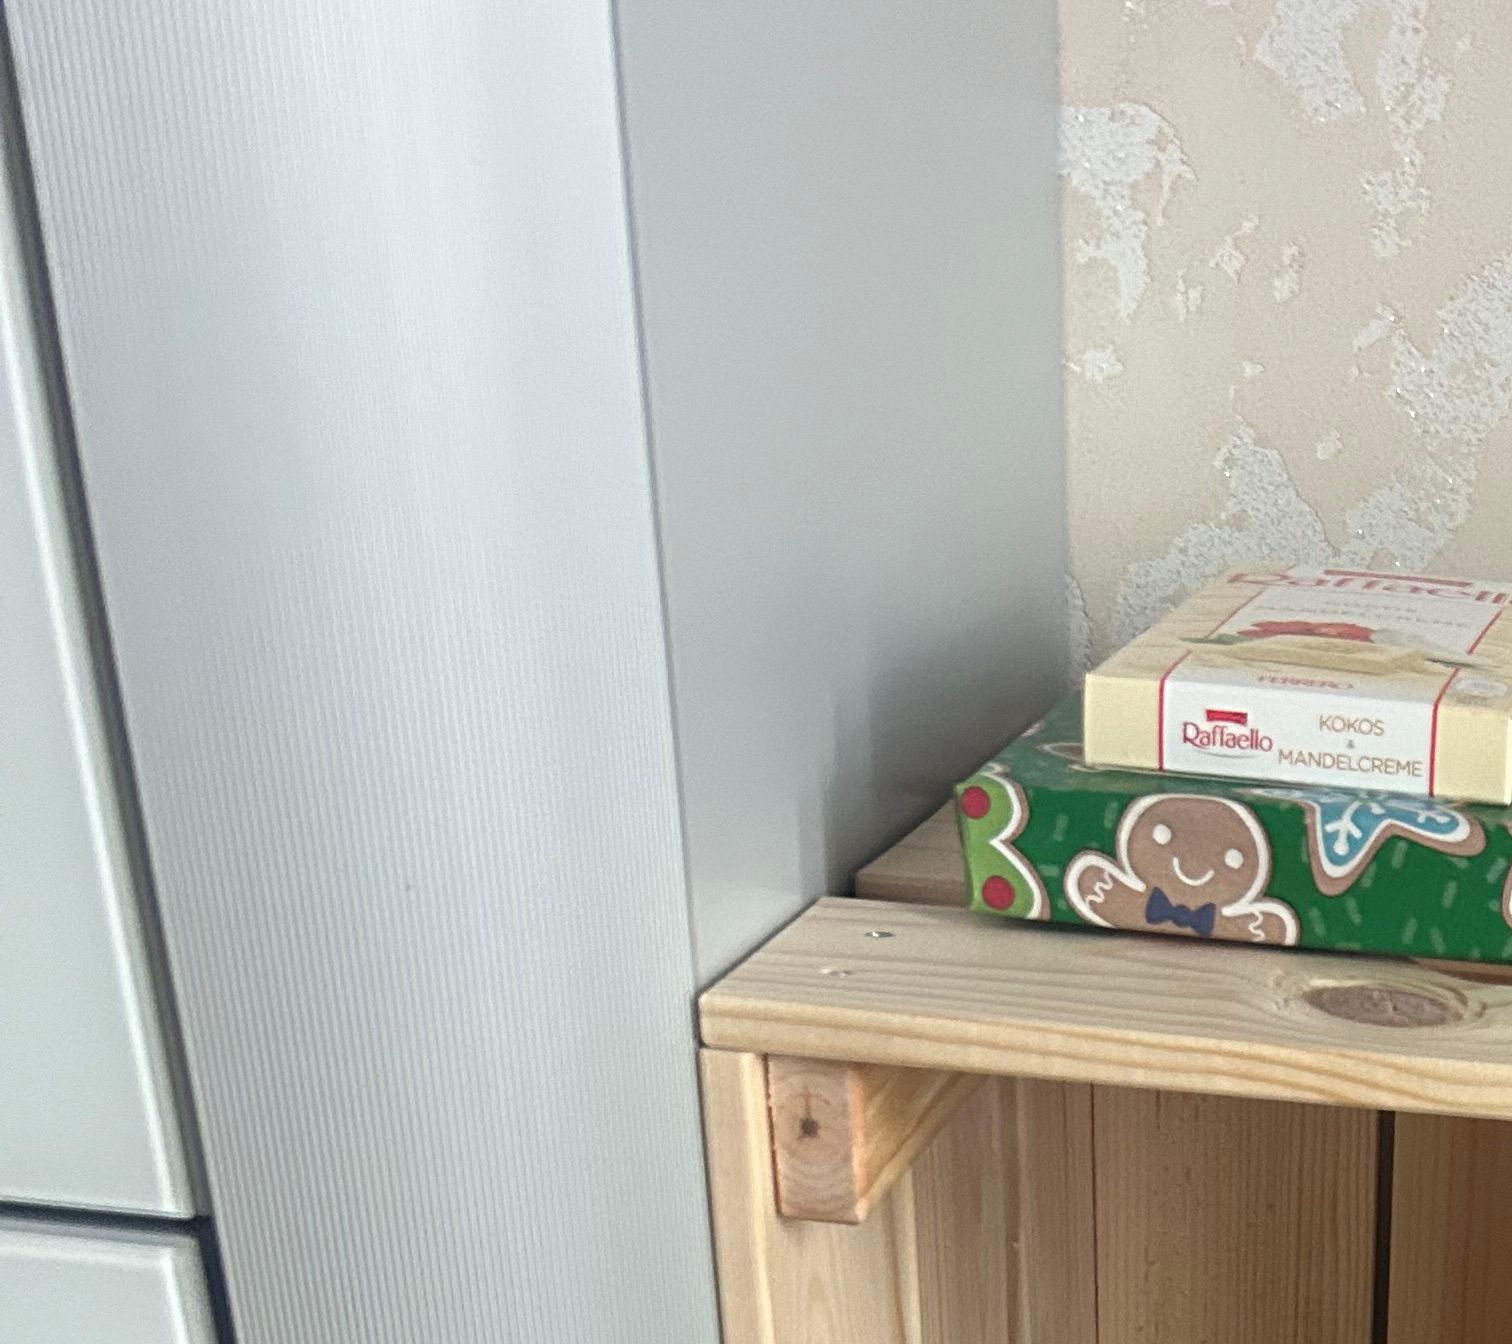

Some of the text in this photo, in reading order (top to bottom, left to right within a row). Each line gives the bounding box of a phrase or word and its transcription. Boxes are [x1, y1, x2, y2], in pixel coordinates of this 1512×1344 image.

[1182, 721, 1274, 752] Raffaello
[1318, 714, 1386, 737] KOKOS
[1277, 749, 1424, 778] MANDELCREME
